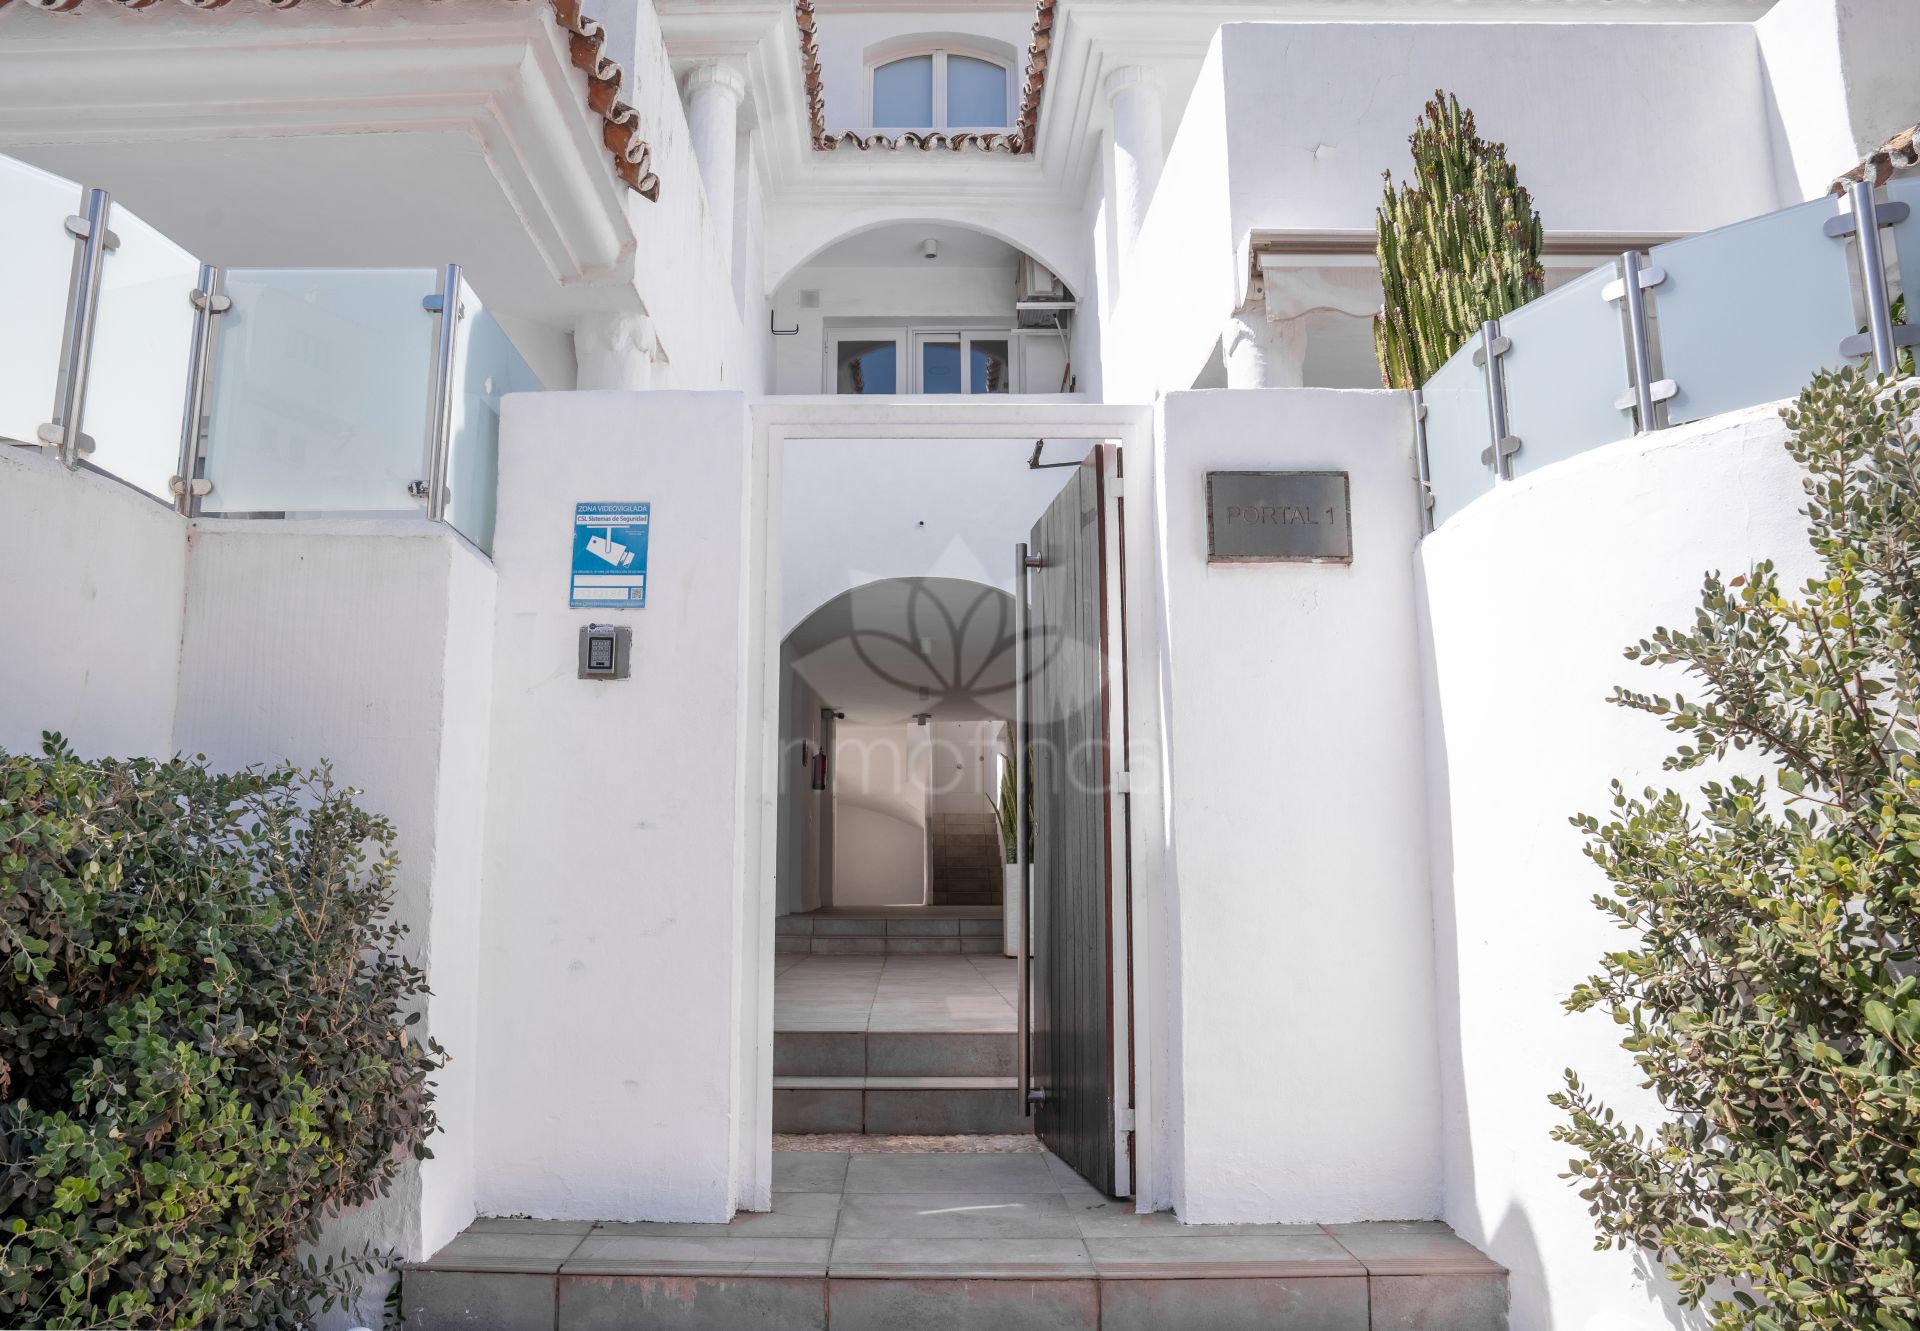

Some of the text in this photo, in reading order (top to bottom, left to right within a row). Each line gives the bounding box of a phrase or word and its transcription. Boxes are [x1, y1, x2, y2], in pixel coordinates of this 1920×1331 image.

[620, 515, 647, 523] Seguridad
[1227, 506, 1334, 525] PORTAL 1
